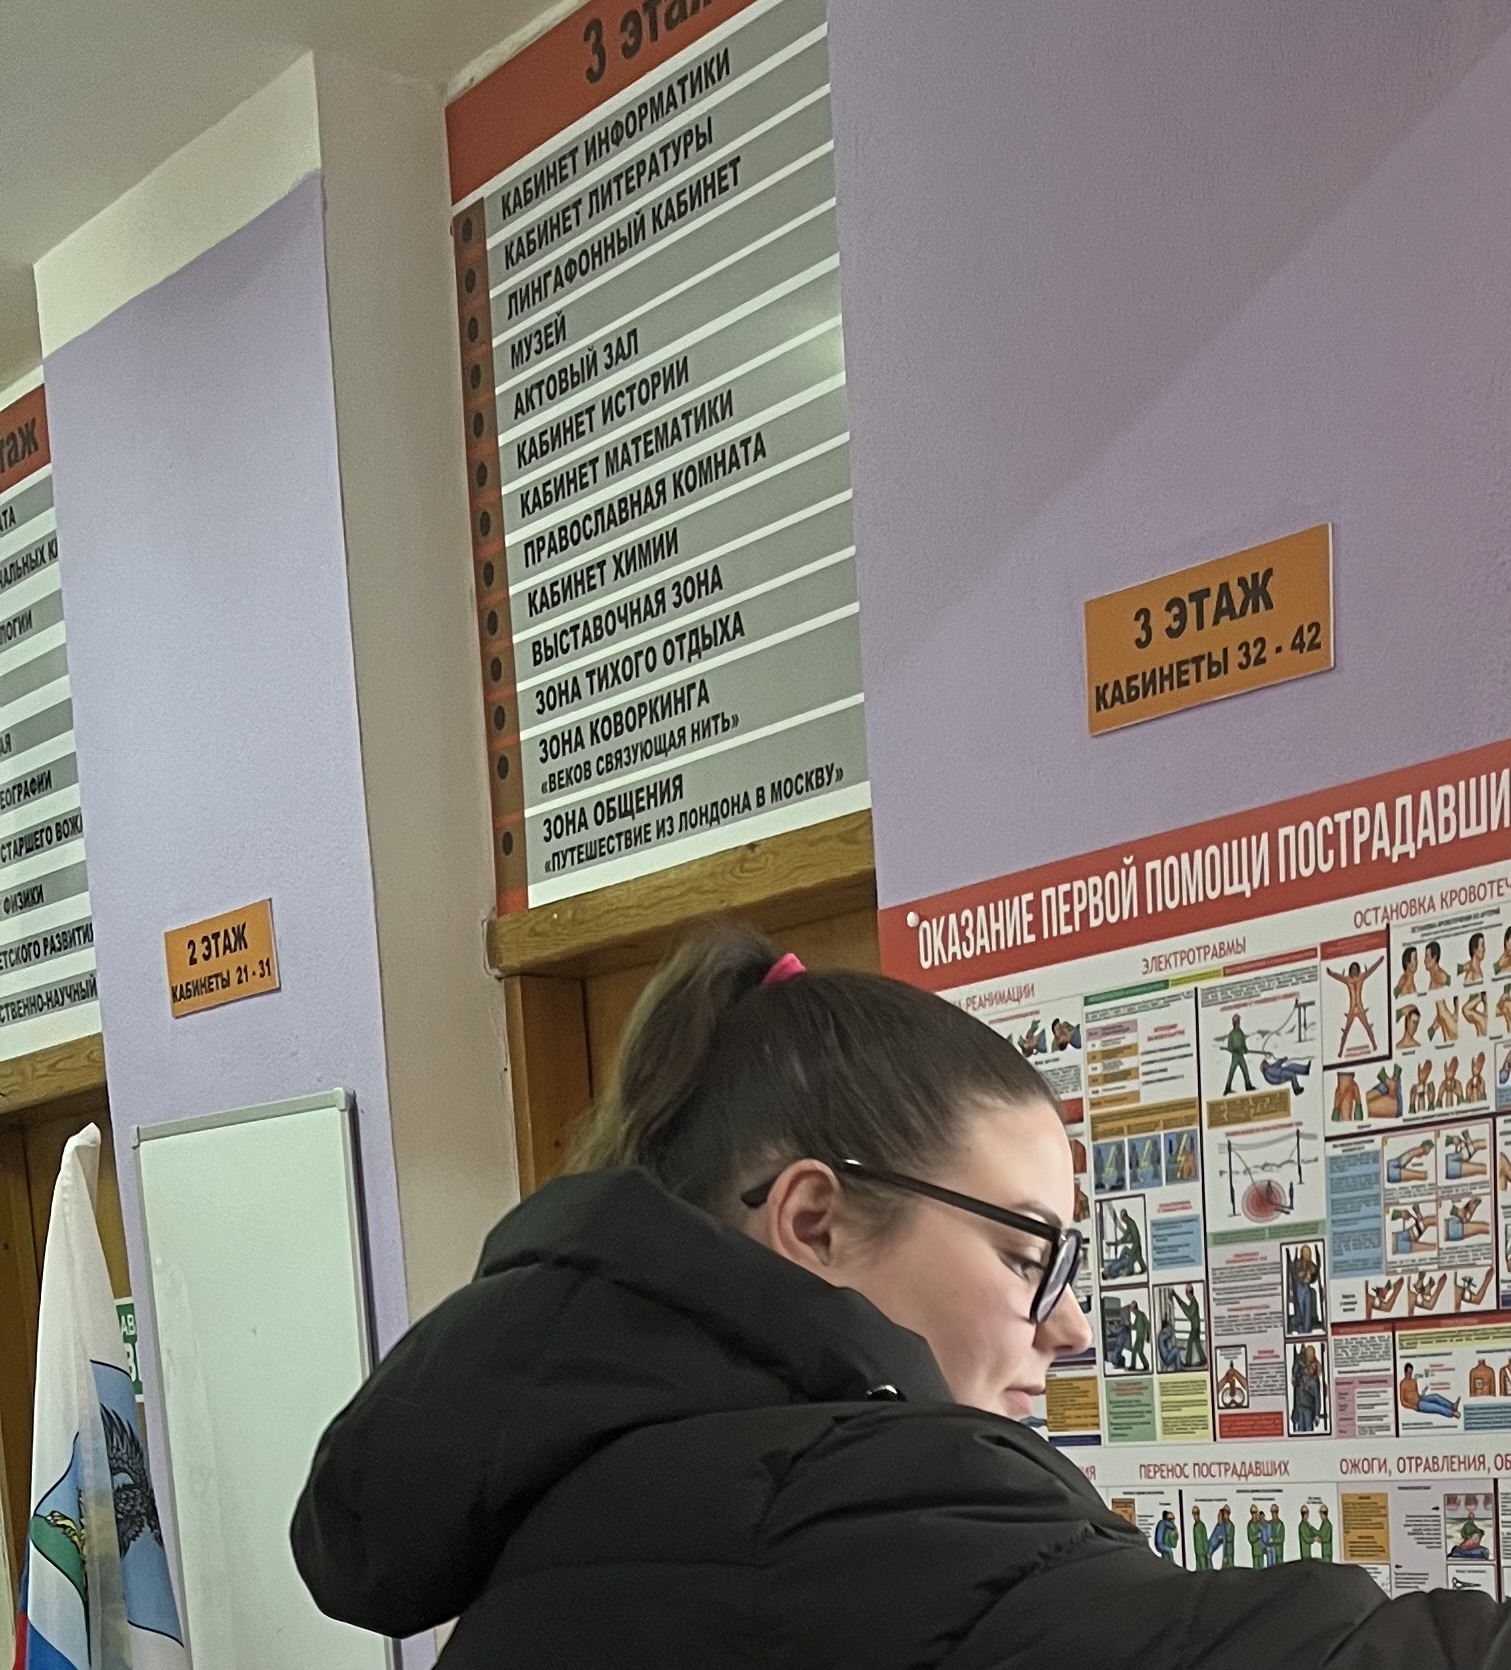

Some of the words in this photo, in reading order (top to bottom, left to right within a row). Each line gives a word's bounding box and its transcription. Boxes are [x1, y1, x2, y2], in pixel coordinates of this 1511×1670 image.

[583, 18, 606, 84] 3
[620, 0, 713, 60] эта
[502, 146, 580, 221] КАБИНЕТ
[584, 47, 731, 167] ИНФОРМАТИКИ
[504, 198, 582, 270] КАБИНЕТ
[588, 116, 713, 220] ЛИТЕРАТУРЫ
[507, 211, 647, 320] ЛИНГАФОННЫЙ
[652, 156, 741, 240] КАБИНЕТ
[511, 311, 567, 370] МУЗЕЙ
[513, 346, 598, 421] АКТОВЫЙ
[603, 328, 639, 371] ЗАЛ
[517, 404, 595, 470] КАБИНЕТ
[601, 355, 689, 427] ИСТОРИИ
[520, 455, 600, 519] КАБИНЕТ
[605, 389, 735, 478] МАТЕМАТИКИ
[524, 479, 667, 568] ПРАВОСЛАВНАЯ
[672, 431, 767, 498] КОМНАТА
[528, 559, 607, 618] КАБИНЕТ
[612, 527, 679, 580] ХИМИИ
[531, 587, 666, 667] ВЫСТАВОЧНАЯ
[672, 564, 723, 609] ЗОНА
[1134, 608, 1152, 649] 3
[1164, 568, 1274, 639] ЭТАЖ
[536, 675, 581, 716] ЗОНА
[586, 647, 658, 697] ТИХОГО
[662, 611, 745, 666] ОТДЫХА
[1095, 648, 1228, 712] КАБИНЕТЫ
[1238, 636, 1266, 670] 32
[1290, 622, 1322, 654] 42
[538, 725, 586, 764] ЗОНА
[590, 678, 711, 747] КОВОРКИНГА
[542, 760, 592, 795] «ВЕКОВ
[596, 726, 687, 776] СВЯЗУЮЩАЯ
[691, 713, 740, 745] НИТЬ»
[1, 825, 53, 863] СТАРШЕГО
[543, 812, 588, 843] ЗОНА
[593, 774, 685, 828] ОБЩЕНИЯ
[545, 824, 653, 873] «ПУТЕШЕСТВИЕ
[656, 818, 674, 838] ИЗ
[678, 791, 752, 832] ЛОНДОНА
[756, 785, 766, 808] В
[770, 763, 844, 803] МОСКВУ»
[3, 884, 44, 915] ФИЗИКИ
[918, 892, 1035, 970] ОКАЗАНИЕ
[1040, 854, 1138, 939] ПЕРВОЙ
[1145, 831, 1271, 915] ПОМОЩИ
[1353, 894, 1437, 929] ОСТАНОВКА
[171, 970, 231, 1003] КАБИНЕТЫ
[236, 964, 248, 985] 21
[258, 957, 271, 978] 31
[187, 939, 198, 966] 2
[201, 922, 248, 961] ЭТАЖ
[1141, 936, 1247, 976] ЭЛЕКТРОТРАВМЫ
[1139, 1462, 1190, 1481] ПЕРЕНОС
[1192, 1459, 1291, 1482] ПОСТРАДАВШИХ
[1339, 1458, 1392, 1477] ОЖОГИ,
[1396, 1453, 1491, 1475] ОТРАВЛЕНИЯ,
